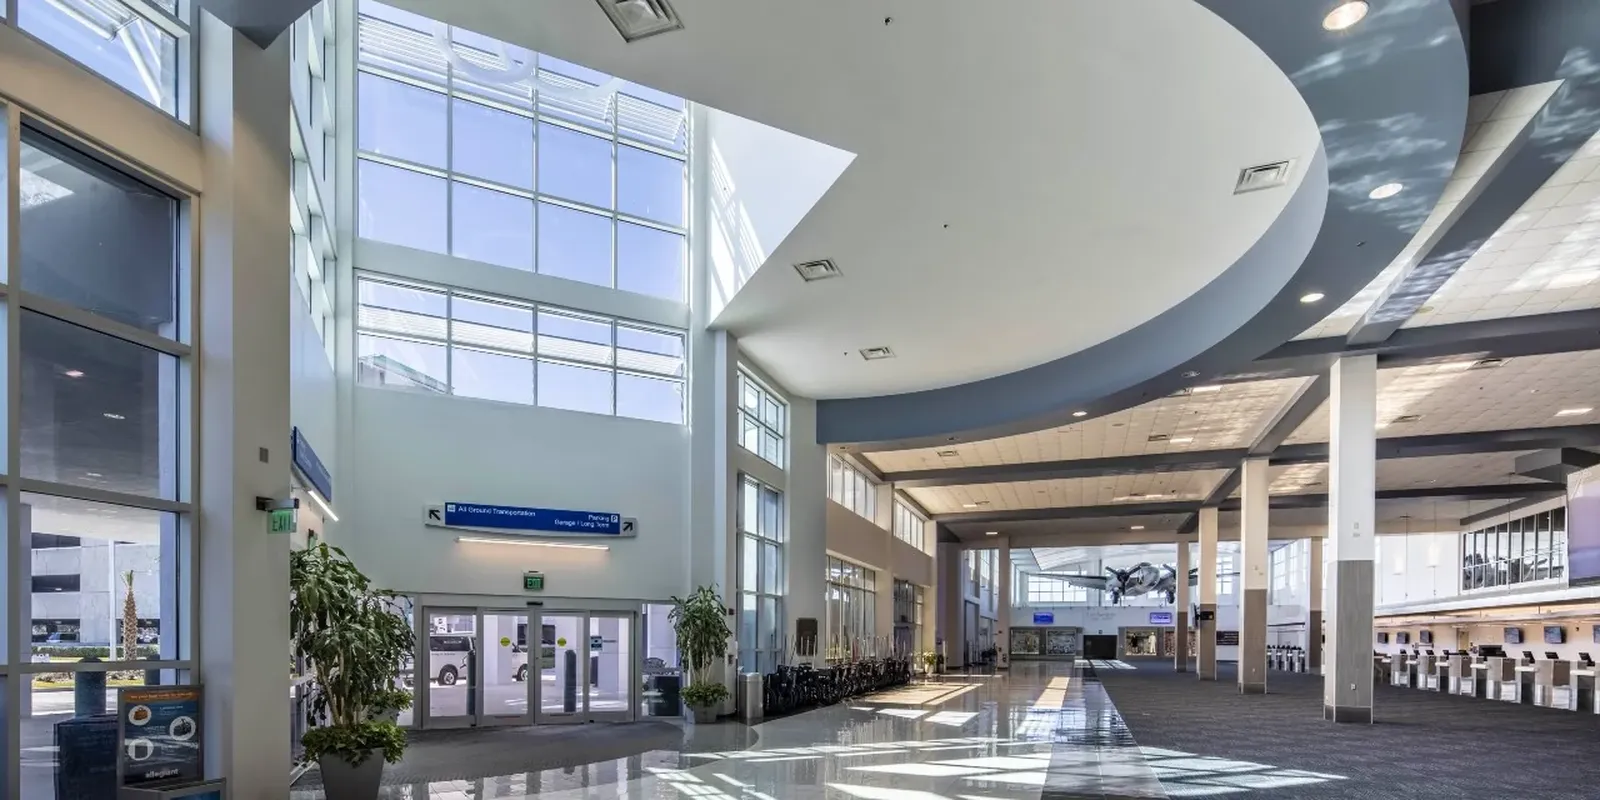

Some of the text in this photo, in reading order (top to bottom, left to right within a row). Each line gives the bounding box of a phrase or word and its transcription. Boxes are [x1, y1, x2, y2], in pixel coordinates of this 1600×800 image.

[468, 507, 492, 515] Ground
[493, 508, 536, 517] Transportation
[271, 513, 291, 532] EXIT
[554, 519, 576, 527] Garage
[588, 514, 609, 523] Parking
